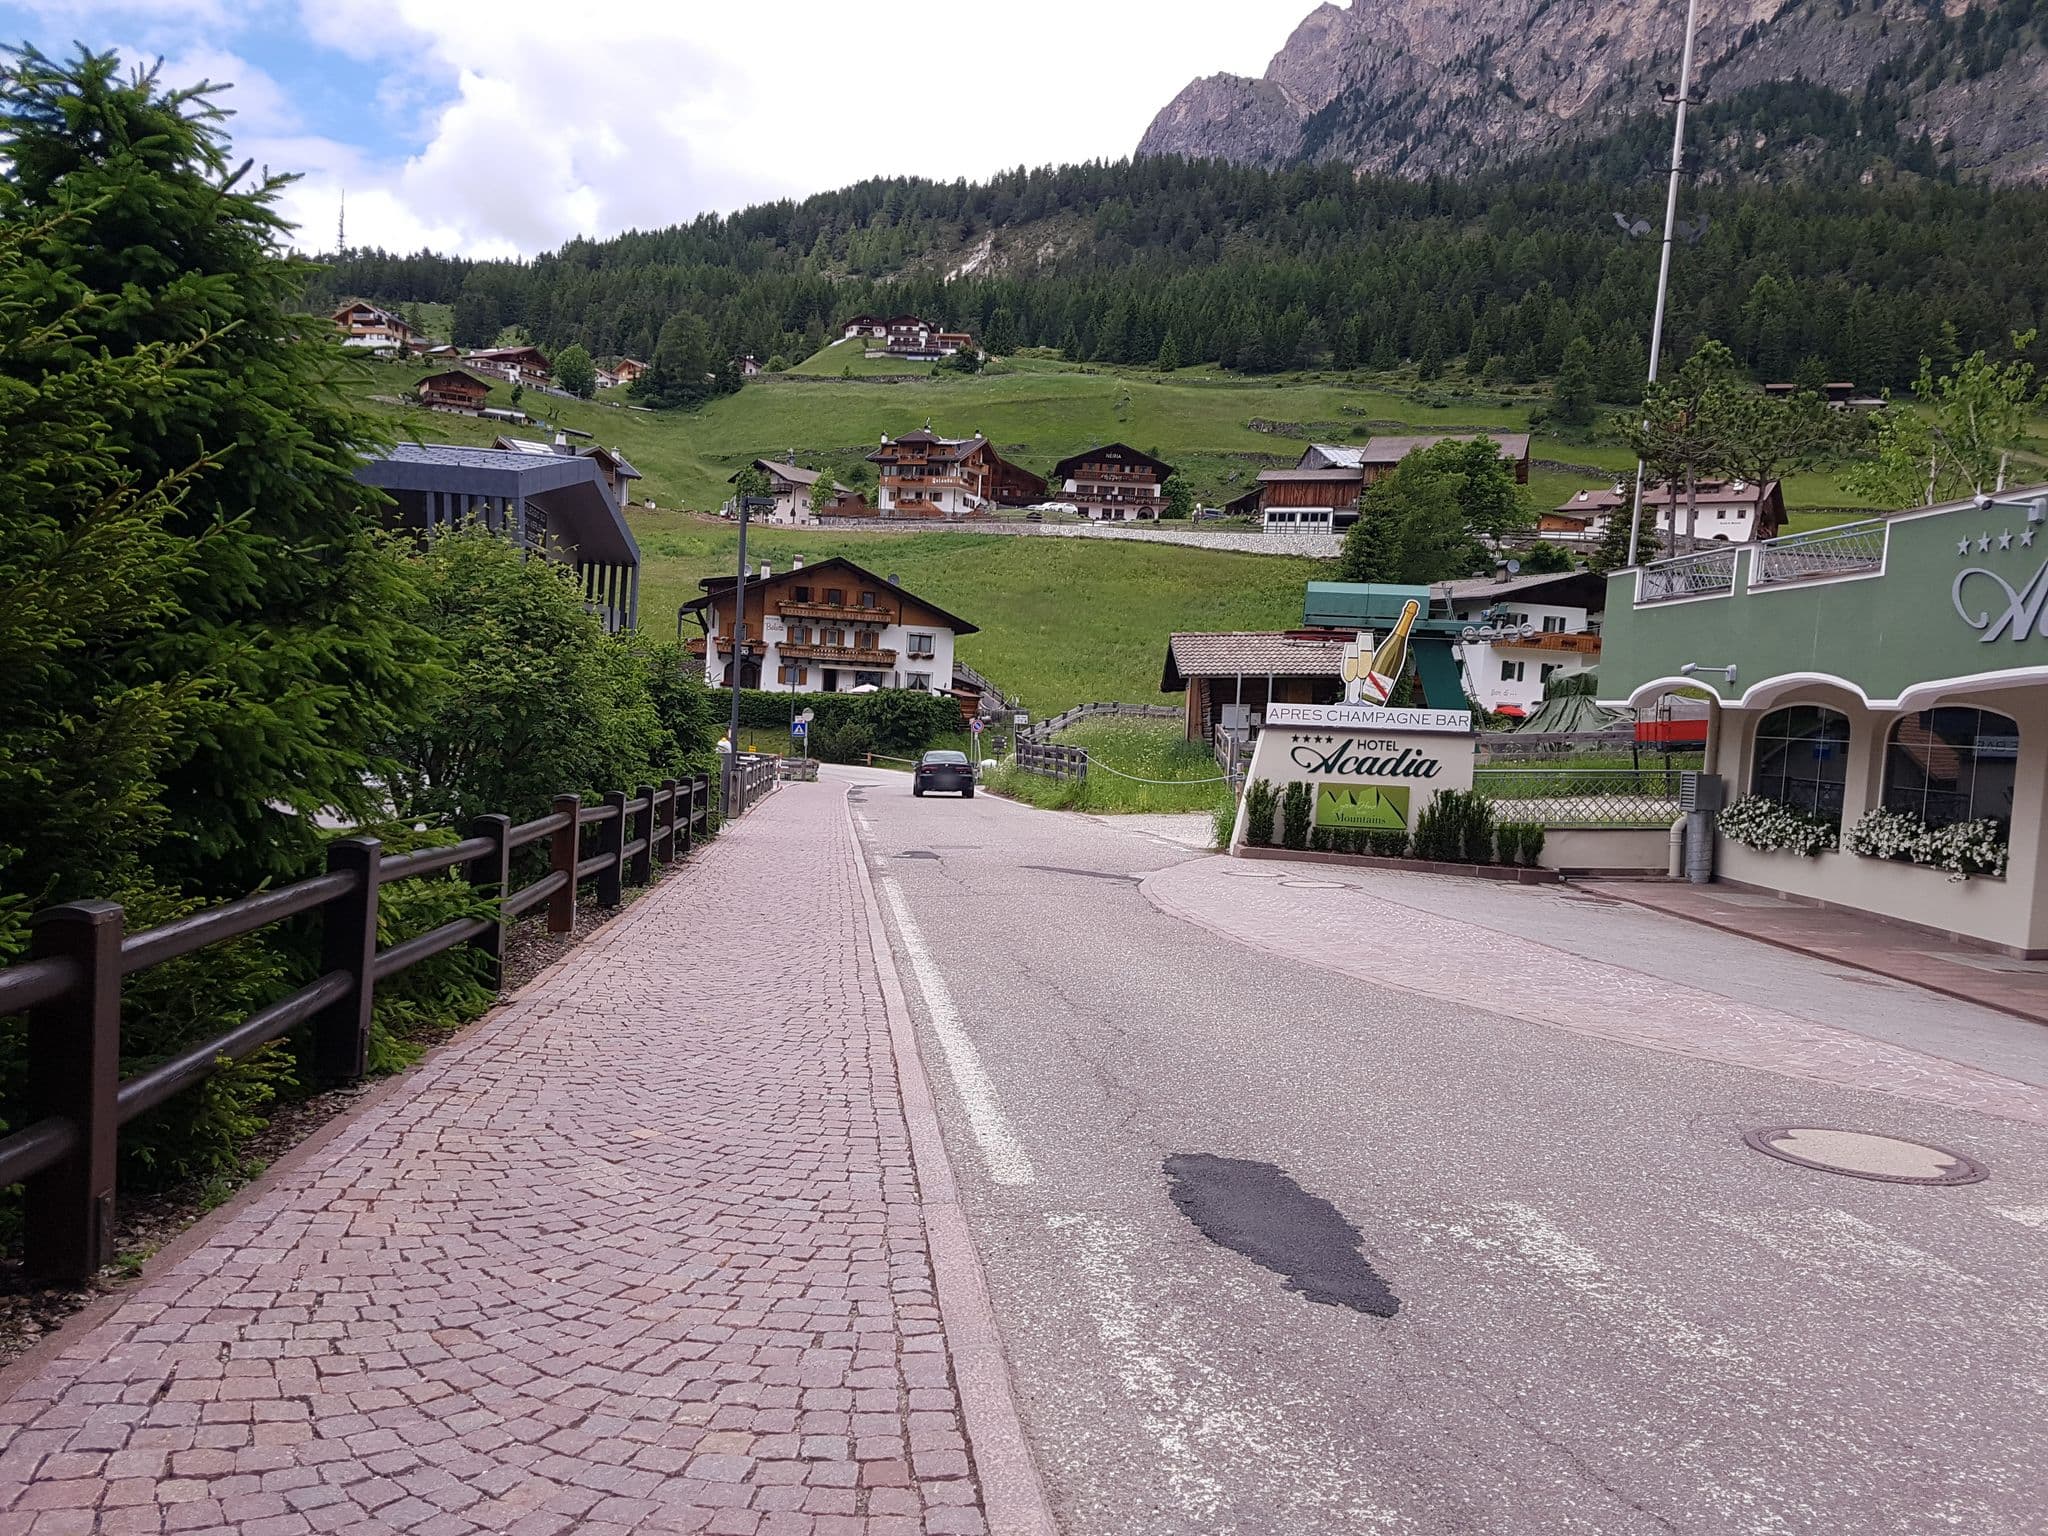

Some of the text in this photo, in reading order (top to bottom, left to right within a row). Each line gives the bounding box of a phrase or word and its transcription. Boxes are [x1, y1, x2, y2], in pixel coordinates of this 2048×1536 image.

[1268, 707, 1470, 728] APRES CHAMPAGNE BAR
[1357, 739, 1399, 752] HOTEL
[1290, 738, 1443, 779] Acadia
[1335, 812, 1386, 824] Mountains
